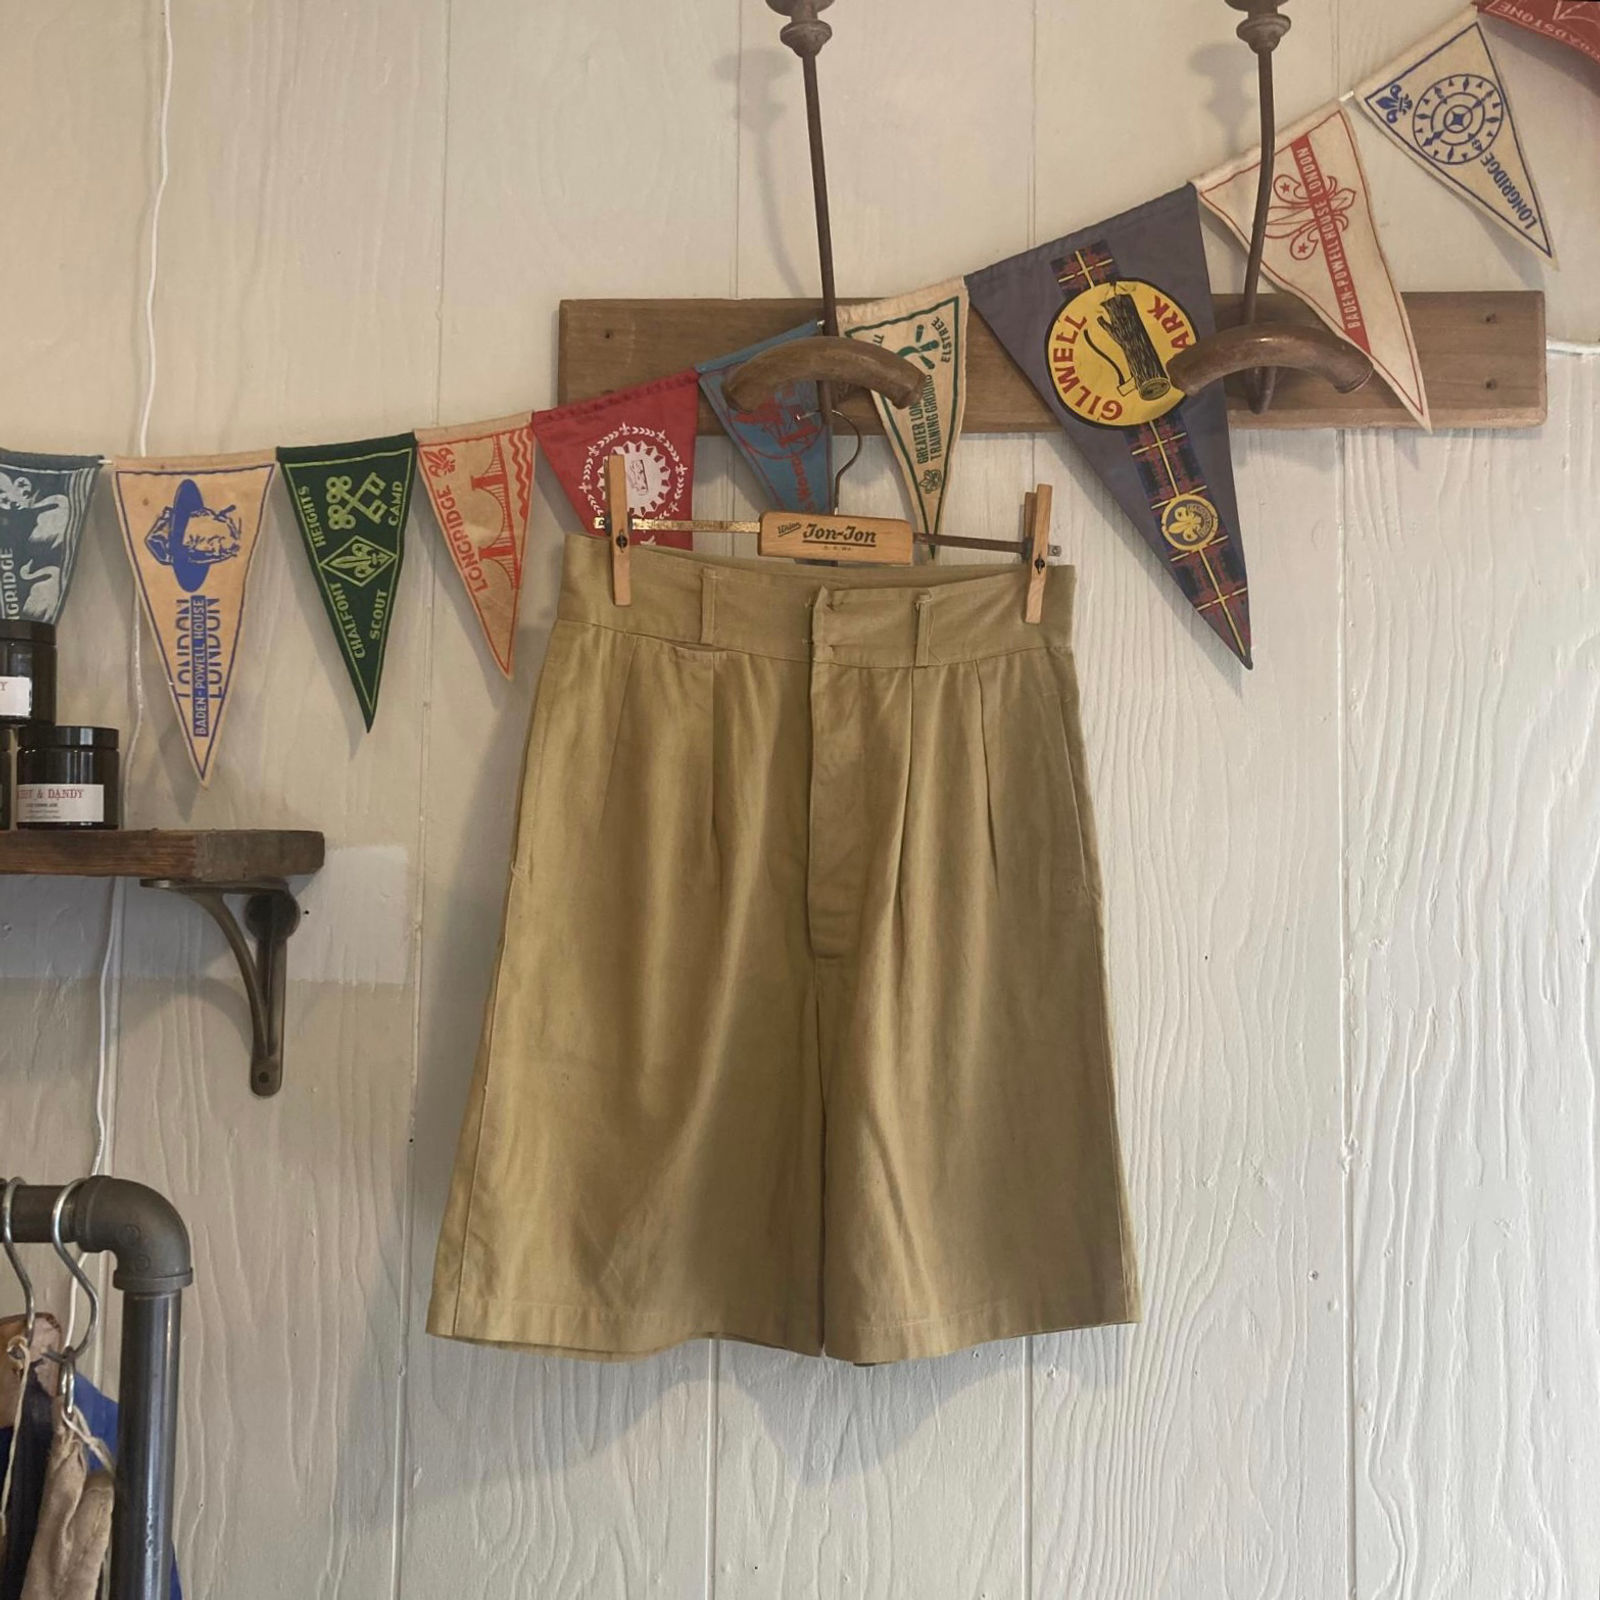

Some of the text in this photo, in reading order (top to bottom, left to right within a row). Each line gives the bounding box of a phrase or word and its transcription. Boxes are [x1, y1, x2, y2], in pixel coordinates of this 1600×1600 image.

[1480, 152, 1537, 229] LONGRIDGE
[1297, 147, 1361, 329] BADEN-POWELL HOUSE LONDON
[931, 316, 952, 363] ELSTREE
[1053, 295, 1190, 421] GILWELL ARK
[908, 401, 929, 464] GREATER LON
[925, 413, 942, 461] TRAINING
[299, 486, 366, 659] CHALFONT HEIGHTS
[369, 481, 403, 641] SCOUT CAMP
[437, 485, 488, 592] LONGRIDGE
[193, 599, 205, 640] HOUSE
[48, 789, 84, 799] DANDY
